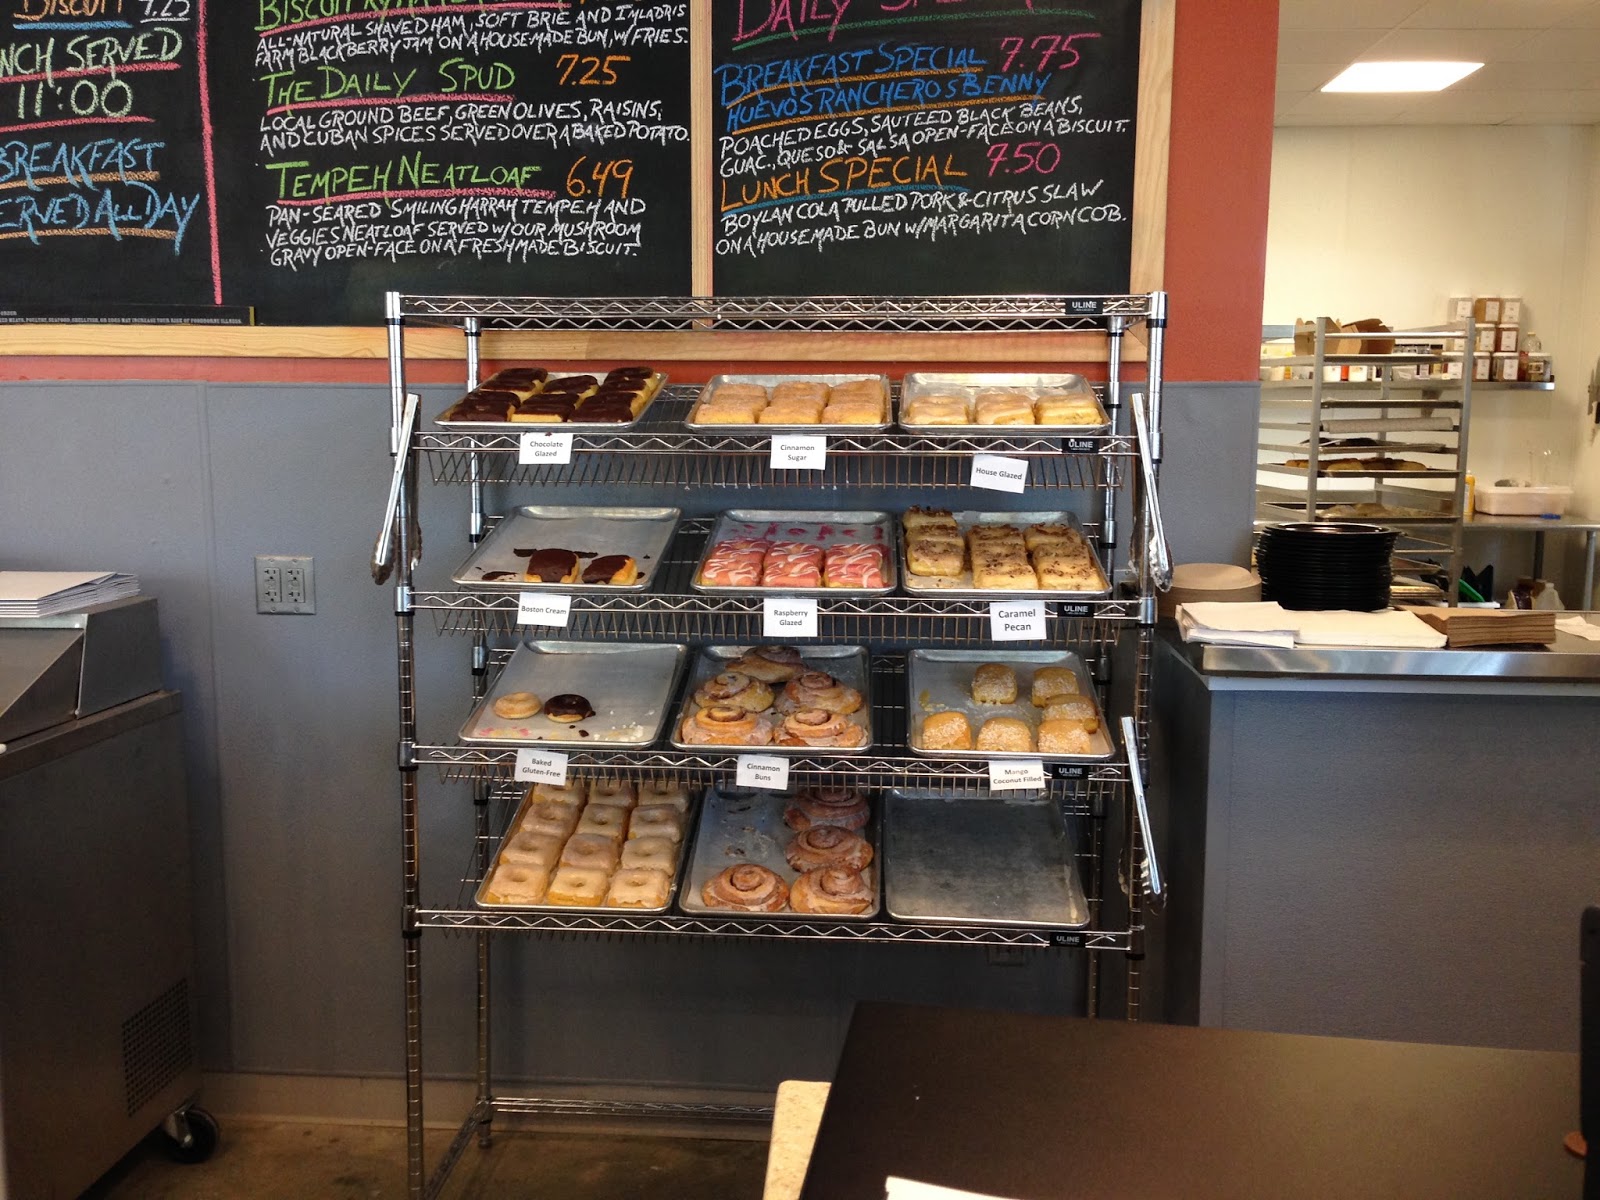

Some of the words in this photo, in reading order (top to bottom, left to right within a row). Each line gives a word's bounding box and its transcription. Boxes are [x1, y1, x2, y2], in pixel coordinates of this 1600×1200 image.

[257, 24, 362, 53] ALL-NATURAL
[365, 17, 428, 42] SHAVED
[475, 11, 523, 29] SOFT
[526, 10, 572, 32] BRIE
[575, 7, 611, 30] AND
[66, 26, 183, 80] SERVED
[255, 47, 296, 73] FARM
[402, 36, 433, 55] JAM
[438, 33, 464, 50] ON
[466, 30, 480, 56] A
[556, 54, 631, 85] 7.25
[1001, 32, 1102, 73] 7.75
[260, 70, 316, 117] THE
[317, 65, 417, 99] DAILY
[438, 57, 515, 92] SPUD
[713, 52, 874, 108] BREAKFAST
[874, 42, 988, 73] SPECIAL
[18, 79, 134, 119] 11:00
[260, 115, 316, 135] LOCAL
[319, 107, 394, 133] GROUND
[397, 104, 453, 127] BEEF,
[455, 102, 513, 127] GREEN
[513, 101, 588, 122] OLIVES,
[726, 92, 815, 132] HUEVOS
[815, 79, 958, 116] RANCHEROS
[959, 72, 1052, 110] BENNY
[260, 132, 300, 158] AND
[303, 127, 368, 151] CUBAN
[372, 125, 436, 144] SPICES
[440, 122, 510, 147] SERVED
[511, 122, 558, 149] OVER
[559, 128, 571, 146] A
[571, 121, 627, 146] BAKED
[626, 120, 690, 146] POTATO.
[719, 127, 811, 160] POACHED
[871, 110, 952, 135] SAUTEED
[956, 106, 1016, 131] BLACK
[857, 132, 910, 158] SALSA
[912, 122, 1014, 145] OPEN-FACE
[1016, 119, 1041, 136] ON
[1043, 119, 1055, 137] A
[1056, 118, 1130, 136] BISCUIT.
[0, 137, 166, 191] BREAKFAST
[566, 155, 634, 199] 6.49
[986, 141, 1061, 178] 7.50
[265, 160, 391, 209] TEMPEH
[397, 151, 542, 190] NEATLOAF
[720, 167, 810, 213] LUNCH
[818, 153, 968, 194] SPECIAL
[94, 187, 143, 242] ALL
[126, 180, 200, 256] DAY
[265, 202, 382, 230] PAN-SEARED
[390, 198, 457, 224] SMILING
[458, 197, 518, 222] HARRAH
[522, 199, 600, 226] TEMPEH
[604, 198, 646, 222] AND
[721, 205, 794, 239] BOYLAN
[796, 201, 840, 222] COLA
[910, 191, 957, 212] PORK
[973, 186, 1039, 215] CITRUS
[1042, 179, 1104, 204] SLAW
[266, 226, 340, 250] VEGGIES
[342, 223, 424, 243] NEATLOAF
[428, 221, 489, 241] SERVED
[548, 222, 642, 247] MUSHROOM
[270, 247, 324, 272] GRAVY
[325, 240, 416, 263] OPEN-FACE
[420, 239, 441, 254] ON
[444, 240, 457, 256] A
[563, 241, 642, 257] BISCUIT.
[715, 237, 742, 255] ON
[743, 235, 757, 258] A
[862, 219, 901, 239] BUN
[1072, 301, 1097, 309] ULINE
[976, 467, 997, 477] House
[999, 471, 1022, 480] Glazed
[998, 608, 1036, 618] Caramel
[1064, 605, 1089, 613] ULINE
[522, 766, 561, 777] Gluten-Free
[532, 758, 552, 766] Baked
[746, 763, 781, 772] Cinnamon
